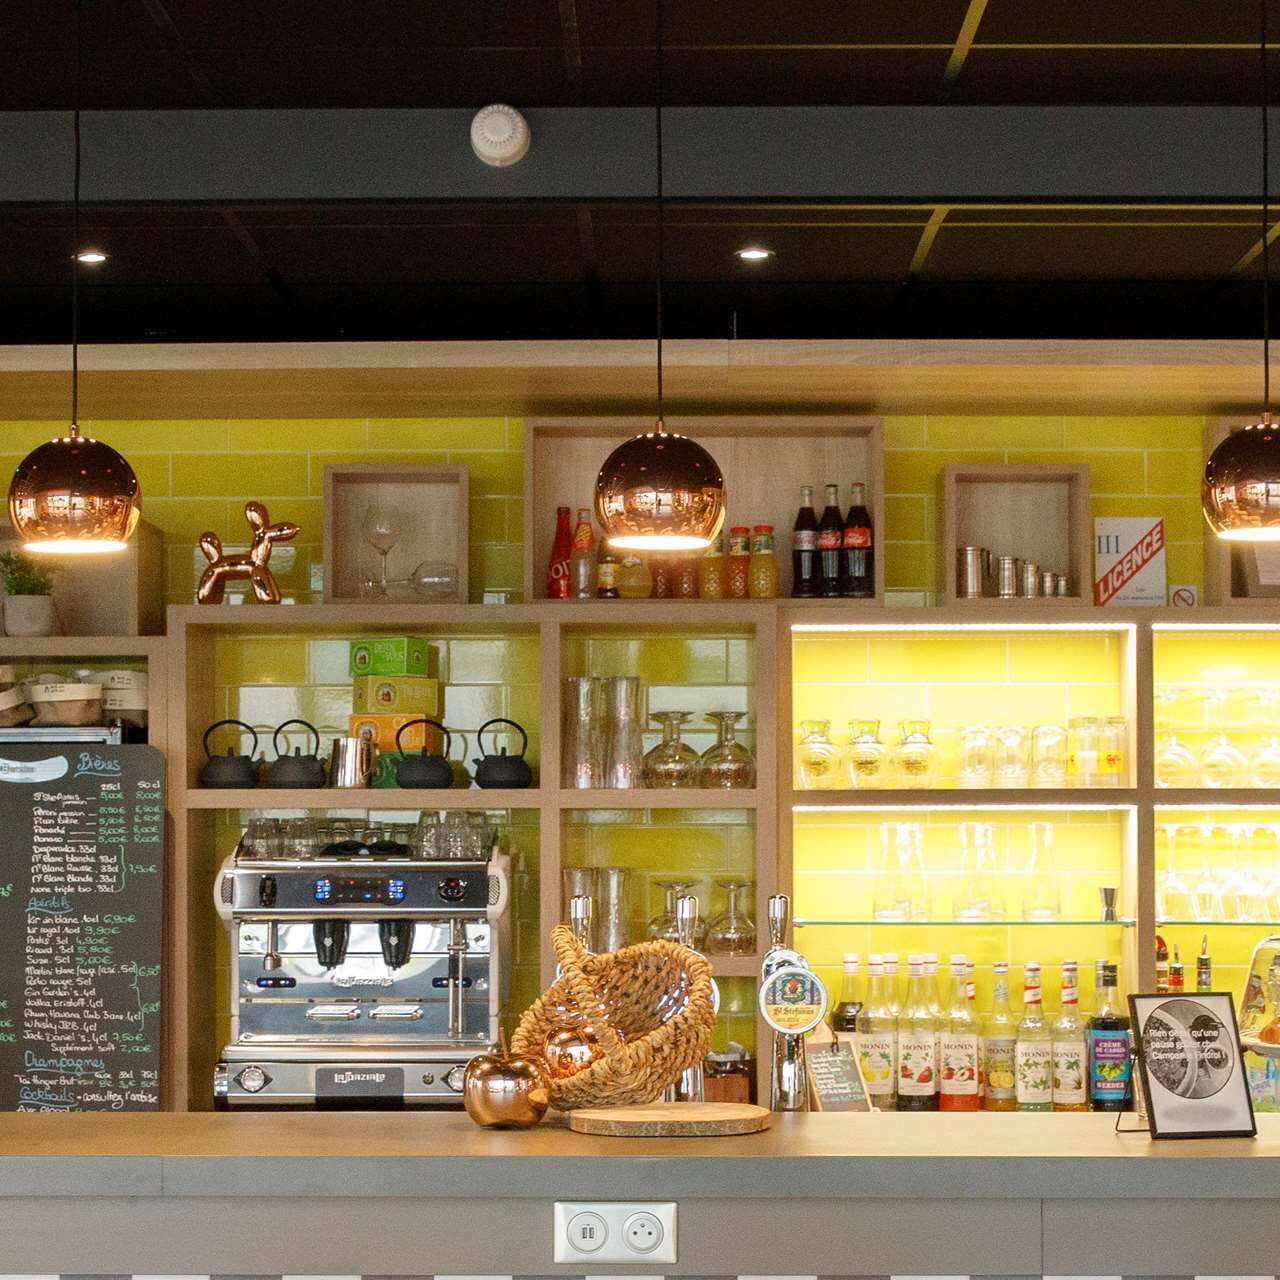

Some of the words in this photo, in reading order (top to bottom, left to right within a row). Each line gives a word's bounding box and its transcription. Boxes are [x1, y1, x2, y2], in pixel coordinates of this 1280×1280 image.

[1099, 523, 1163, 603] LICENCE
[77, 752, 121, 771] Bières
[1191, 1029, 1219, 1038] qu'une
[19, 1086, 76, 1101] Cocktails
